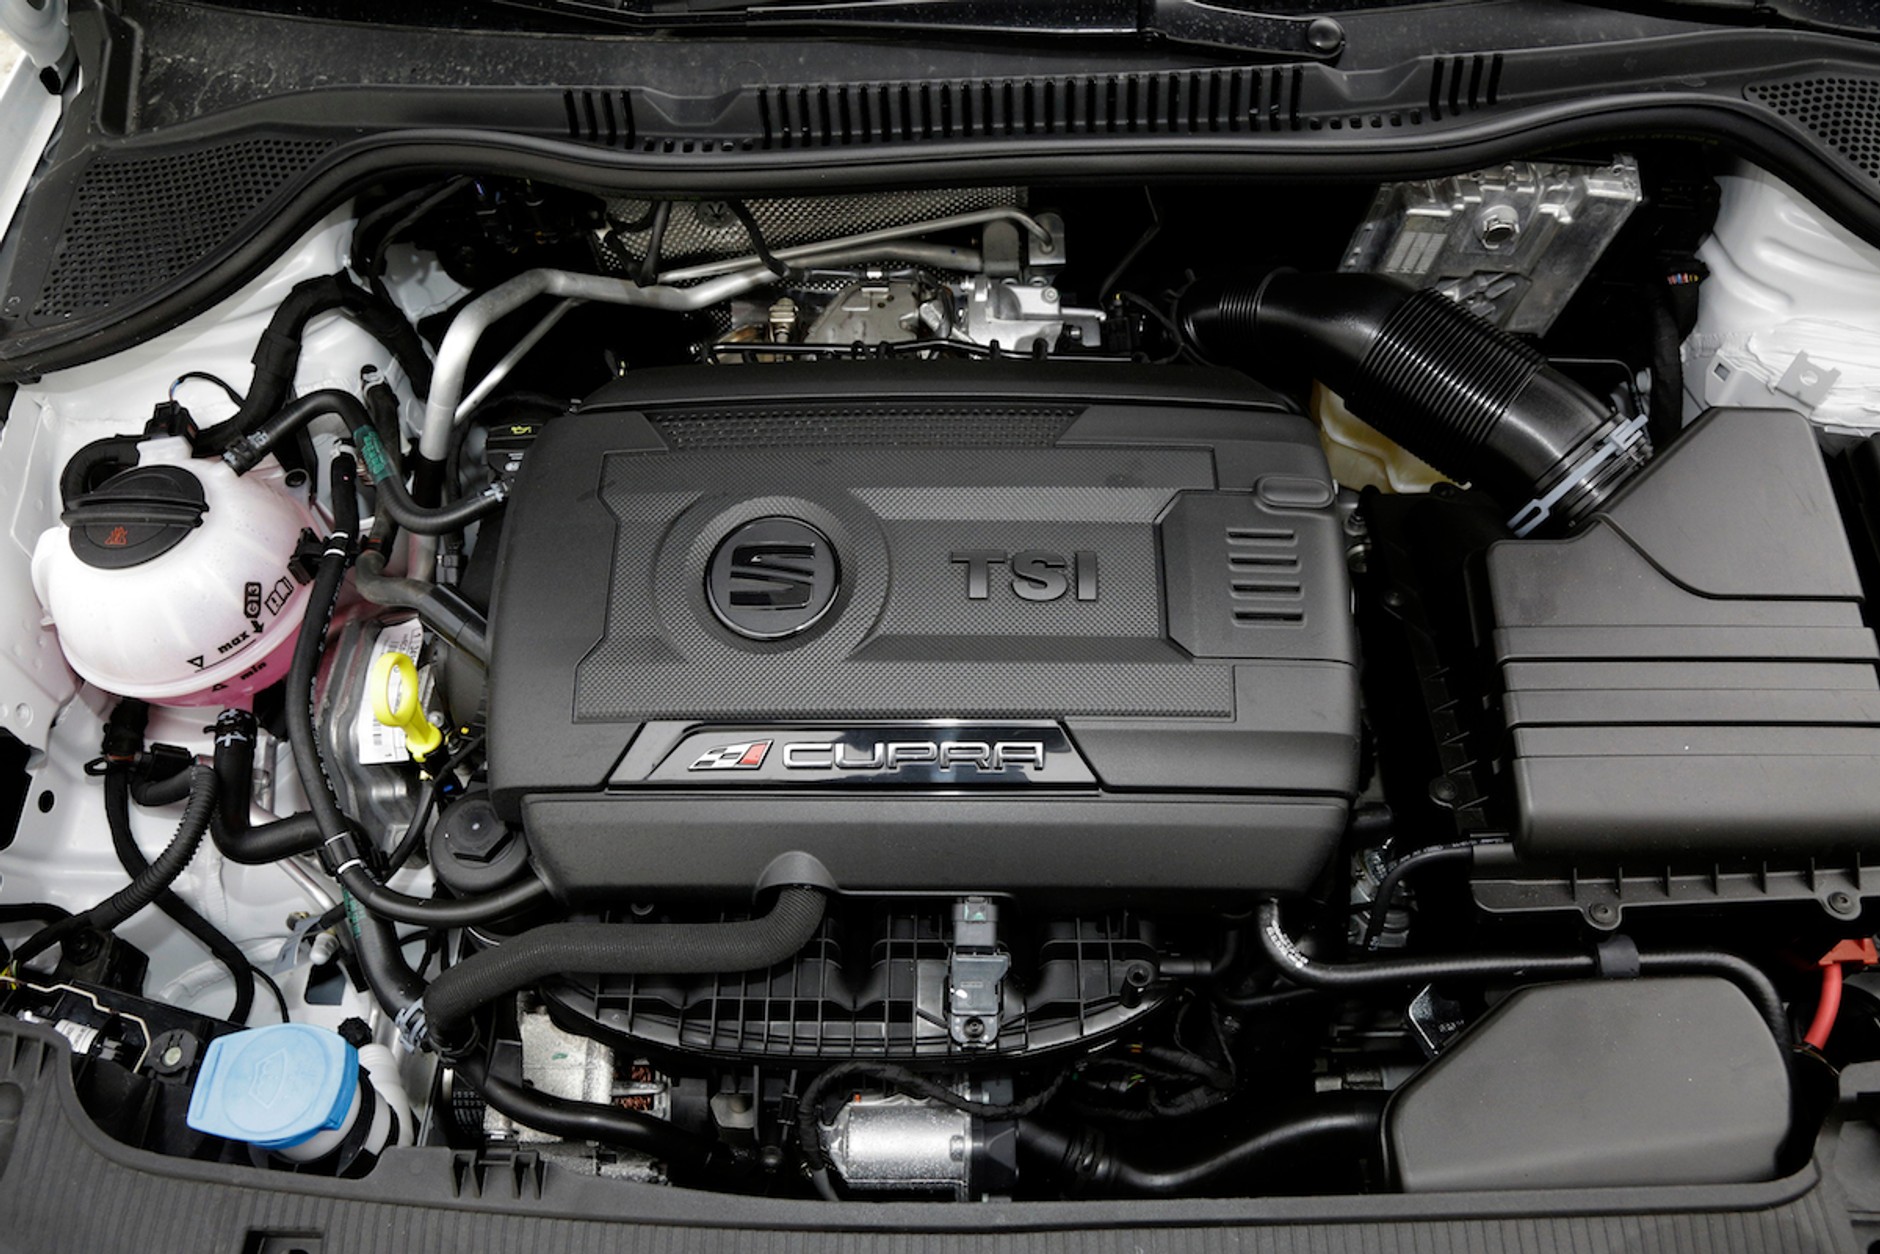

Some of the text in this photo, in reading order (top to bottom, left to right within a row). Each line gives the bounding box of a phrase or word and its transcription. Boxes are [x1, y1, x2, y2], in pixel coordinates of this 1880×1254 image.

[950, 549, 1097, 602] TSI
[217, 631, 250, 654] max
[240, 661, 267, 680] min
[782, 740, 1043, 771] CUPRA
